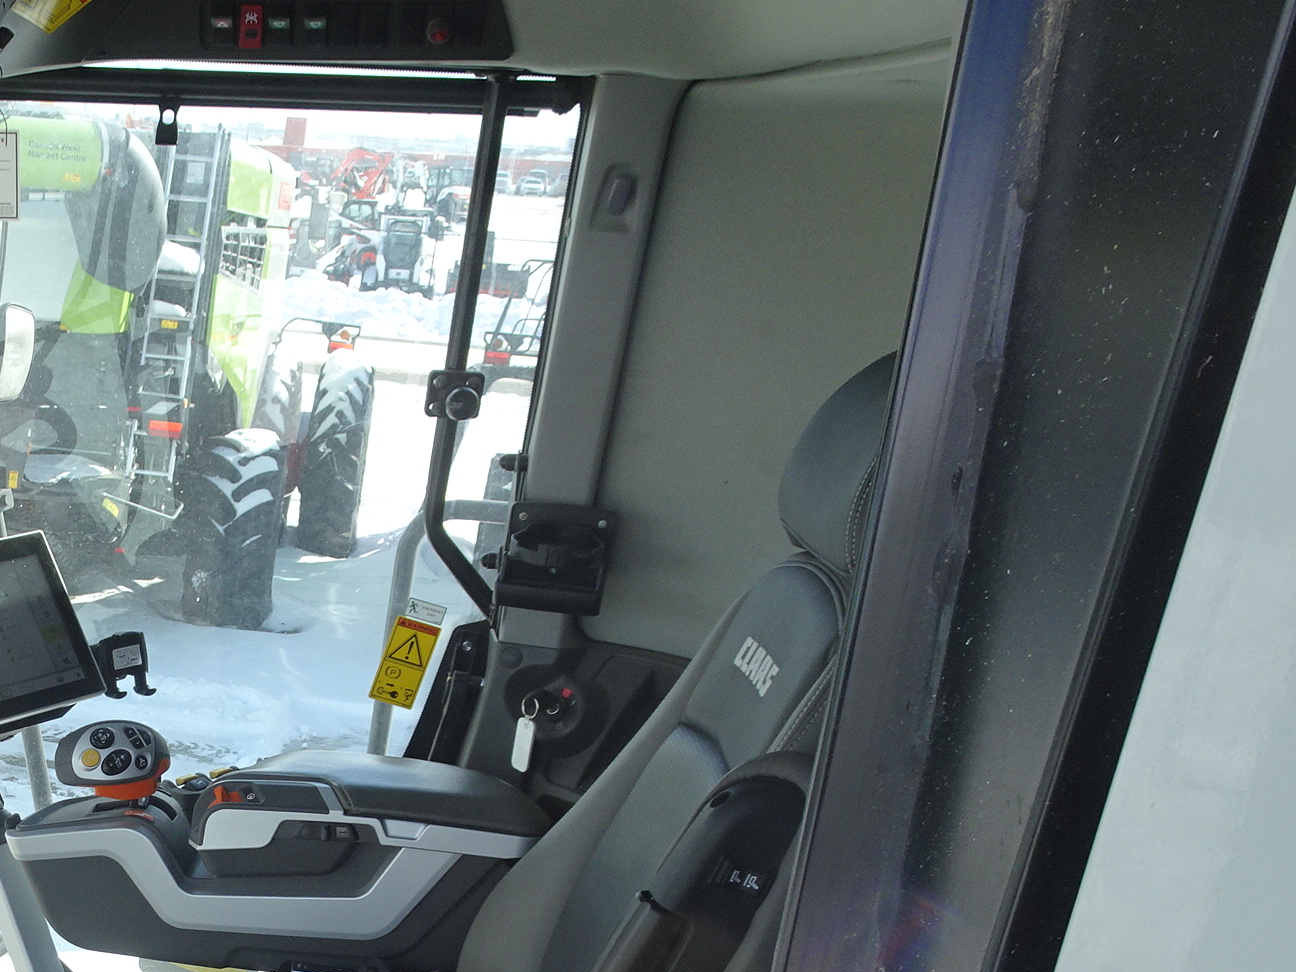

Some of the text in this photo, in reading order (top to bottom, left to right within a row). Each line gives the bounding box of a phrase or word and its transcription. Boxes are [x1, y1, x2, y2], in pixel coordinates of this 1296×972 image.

[60, 152, 87, 163] Centre
[408, 621, 437, 634] WARNING
[733, 636, 780, 698] CLAAS
